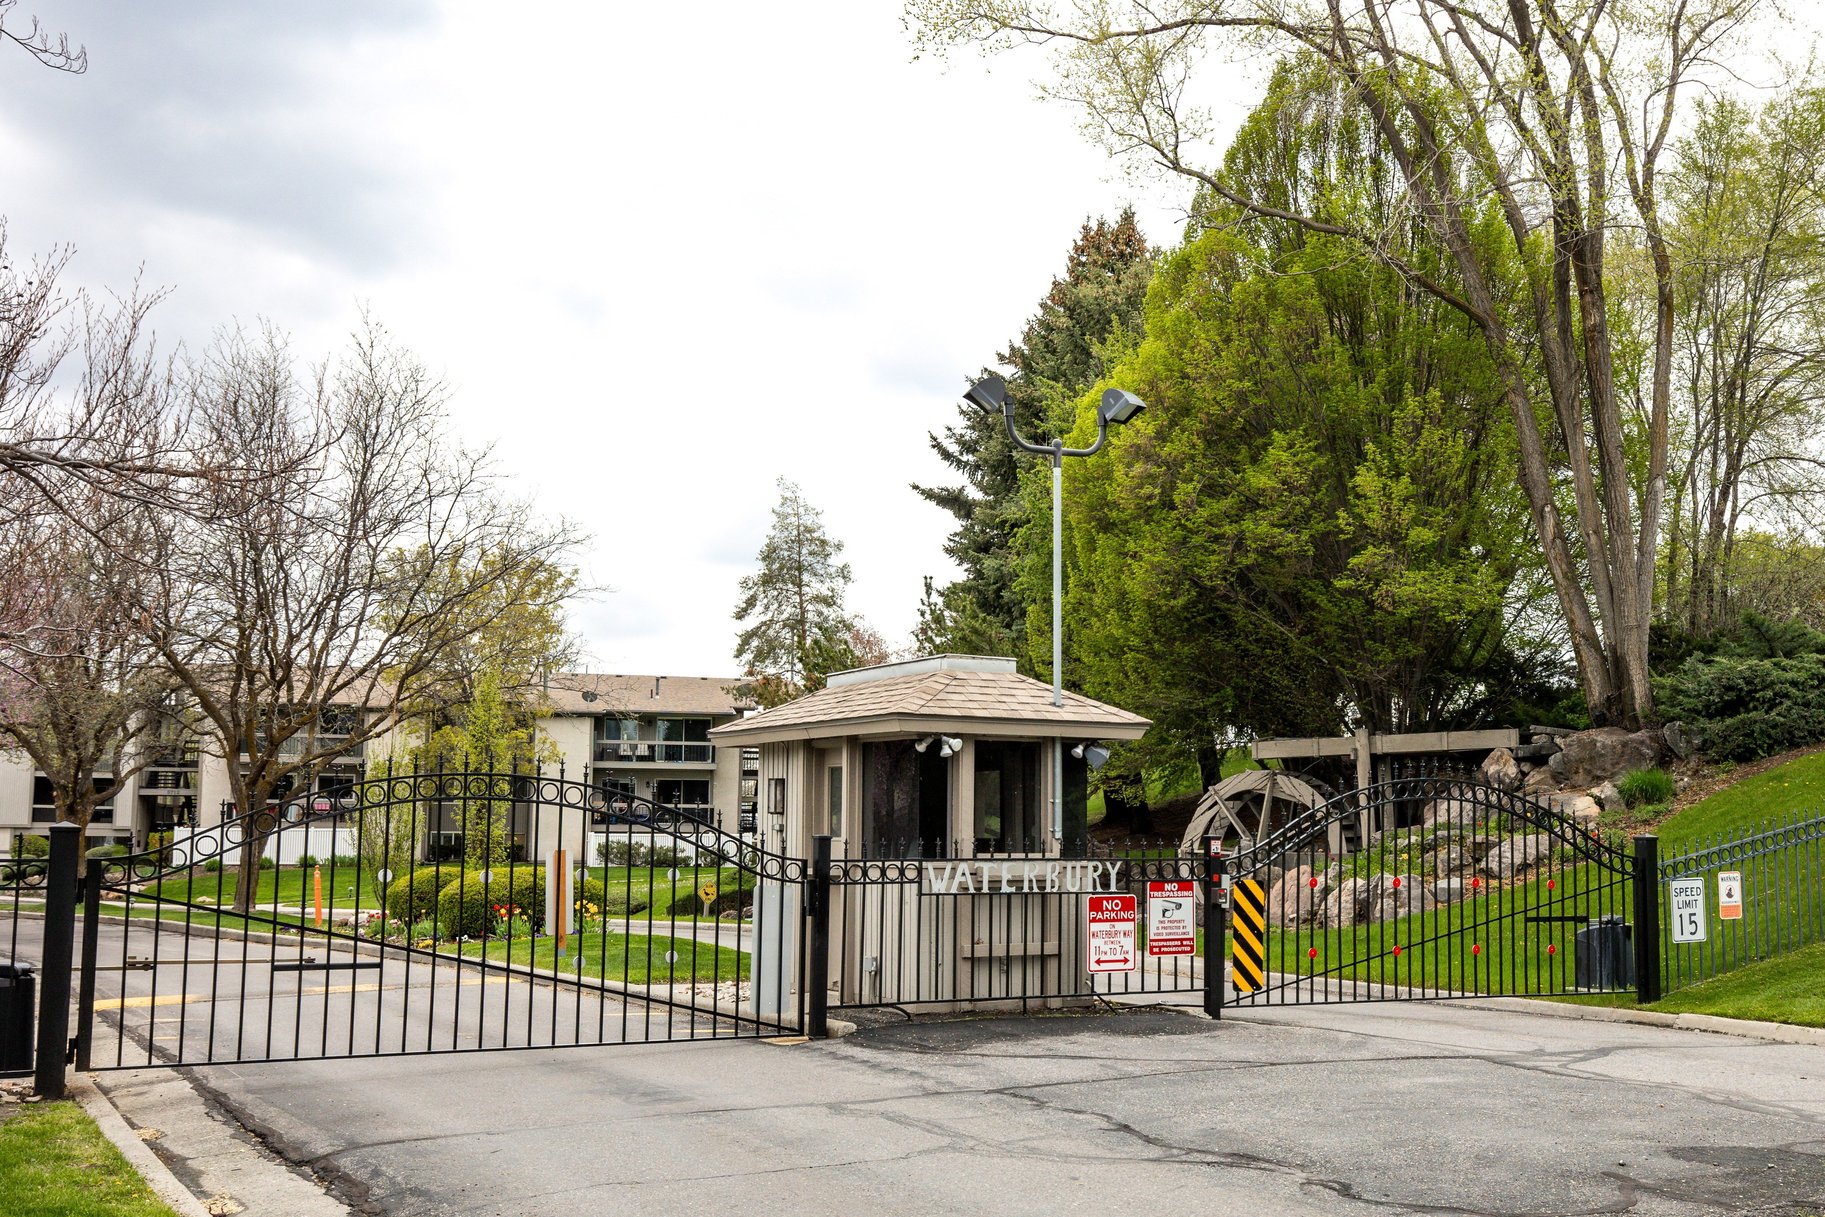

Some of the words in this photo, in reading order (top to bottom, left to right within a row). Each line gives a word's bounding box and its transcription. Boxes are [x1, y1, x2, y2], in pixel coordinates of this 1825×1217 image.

[927, 861, 1122, 892] WATERBURY
[1164, 883, 1179, 891] NO
[1673, 886, 1702, 897] SPEED
[1103, 899, 1121, 910] NO
[1677, 899, 1698, 910] LIMIT
[1090, 911, 1134, 920] PARKING
[1679, 913, 1698, 936] 15
[1091, 930, 1121, 939] WATERBURY
[1123, 930, 1133, 938] WAY
[1109, 947, 1117, 955] TO
